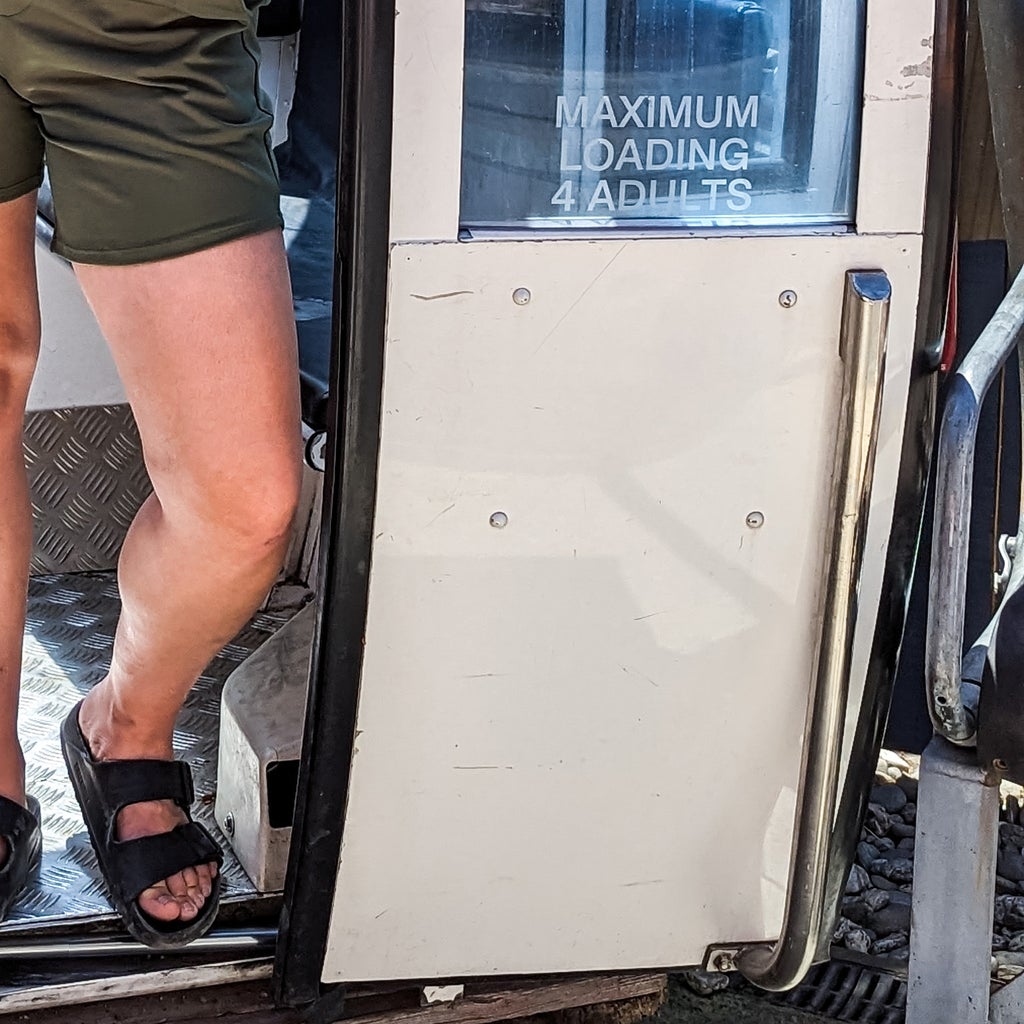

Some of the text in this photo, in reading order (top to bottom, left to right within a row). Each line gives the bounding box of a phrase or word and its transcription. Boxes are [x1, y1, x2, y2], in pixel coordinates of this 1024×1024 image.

[555, 95, 759, 128] MAXIMUM
[560, 137, 749, 172] LOADING
[551, 178, 753, 212] 4 ADULTS
